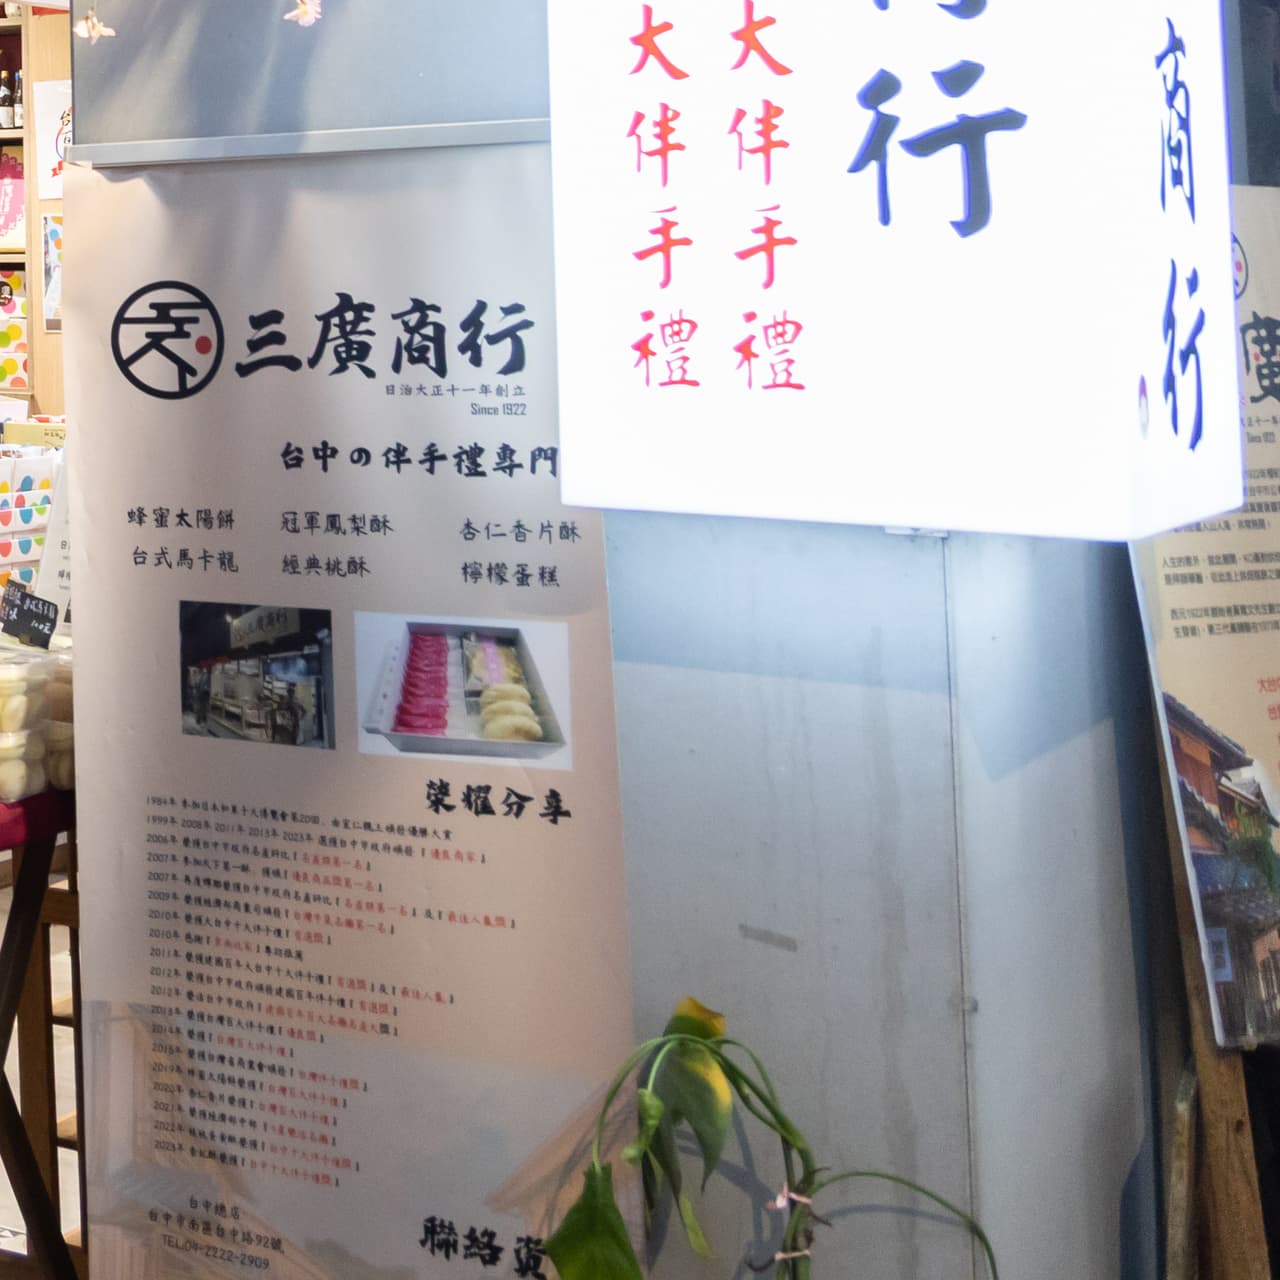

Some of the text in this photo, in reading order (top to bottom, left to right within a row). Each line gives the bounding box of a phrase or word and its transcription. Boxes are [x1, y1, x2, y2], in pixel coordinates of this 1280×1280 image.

[235, 292, 535, 379] 三廣商行
[385, 383, 527, 398] 日治大正十一年創立
[470, 402, 527, 417] Since 1922
[127, 506, 236, 531] 蜂蜜太陽餅
[280, 511, 394, 537] 冠軍鳳梨酥
[460, 517, 581, 544] 杏仁香片酥
[132, 546, 239, 573] 台式馬卡龍
[281, 555, 371, 578] 經典桃酥
[461, 562, 560, 588] 檸檬蛋糕
[425, 777, 571, 825] 榮耀分享
